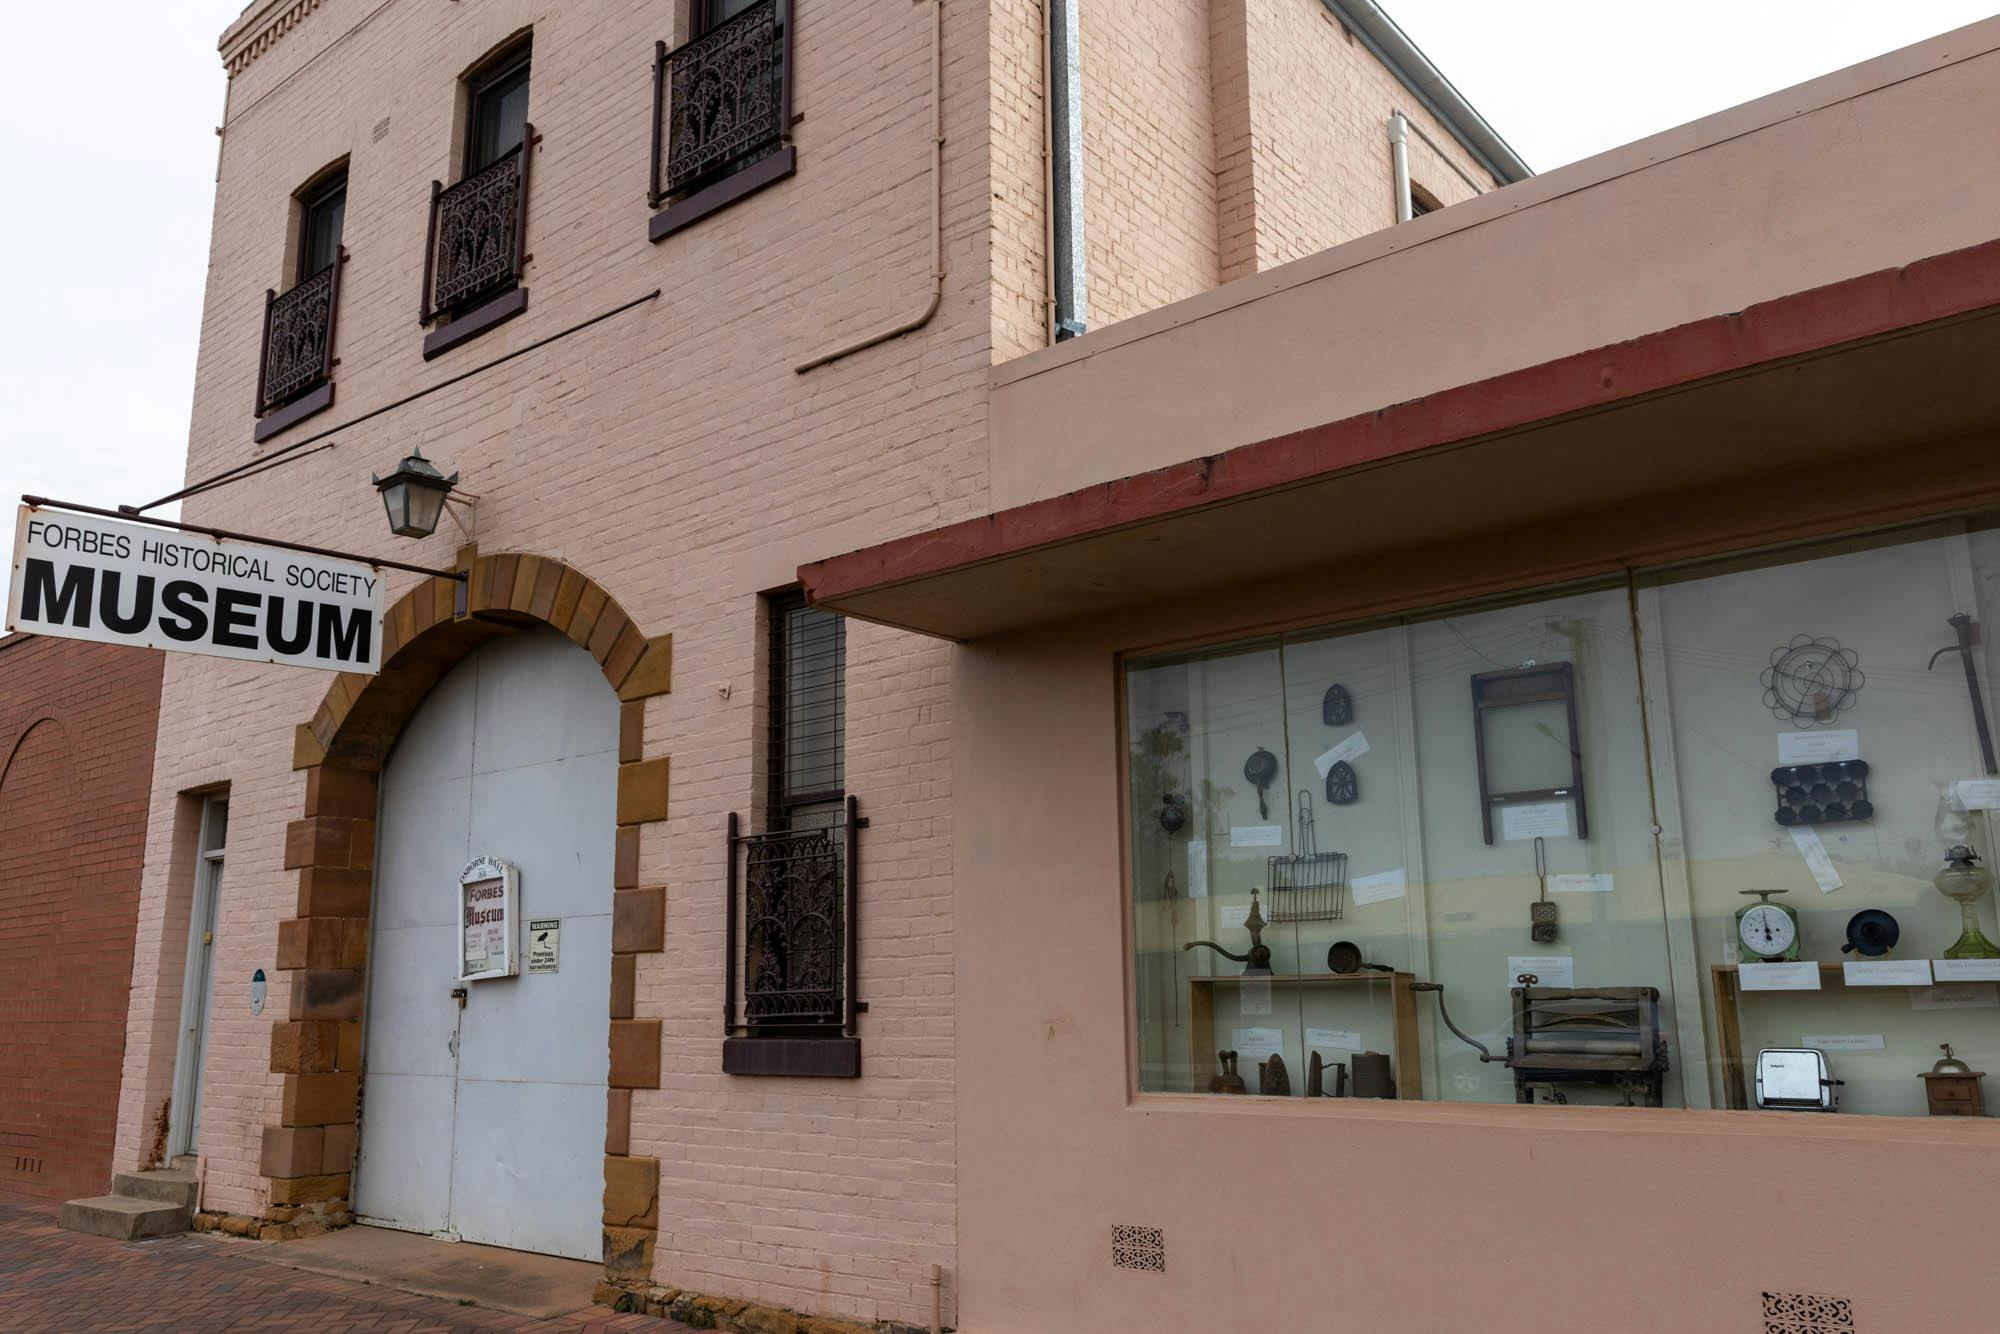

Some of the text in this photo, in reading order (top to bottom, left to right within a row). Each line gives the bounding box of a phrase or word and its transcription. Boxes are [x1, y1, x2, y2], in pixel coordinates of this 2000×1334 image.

[27, 521, 376, 598] FORBES HISTORICAL SOCIETY
[20, 557, 373, 664] MUSEUM
[459, 857, 486, 883] OSBORNE
[488, 856, 504, 873] HALL
[470, 885, 503, 901] FORBES
[465, 906, 504, 928] Museum
[532, 921, 558, 929] WARNING
